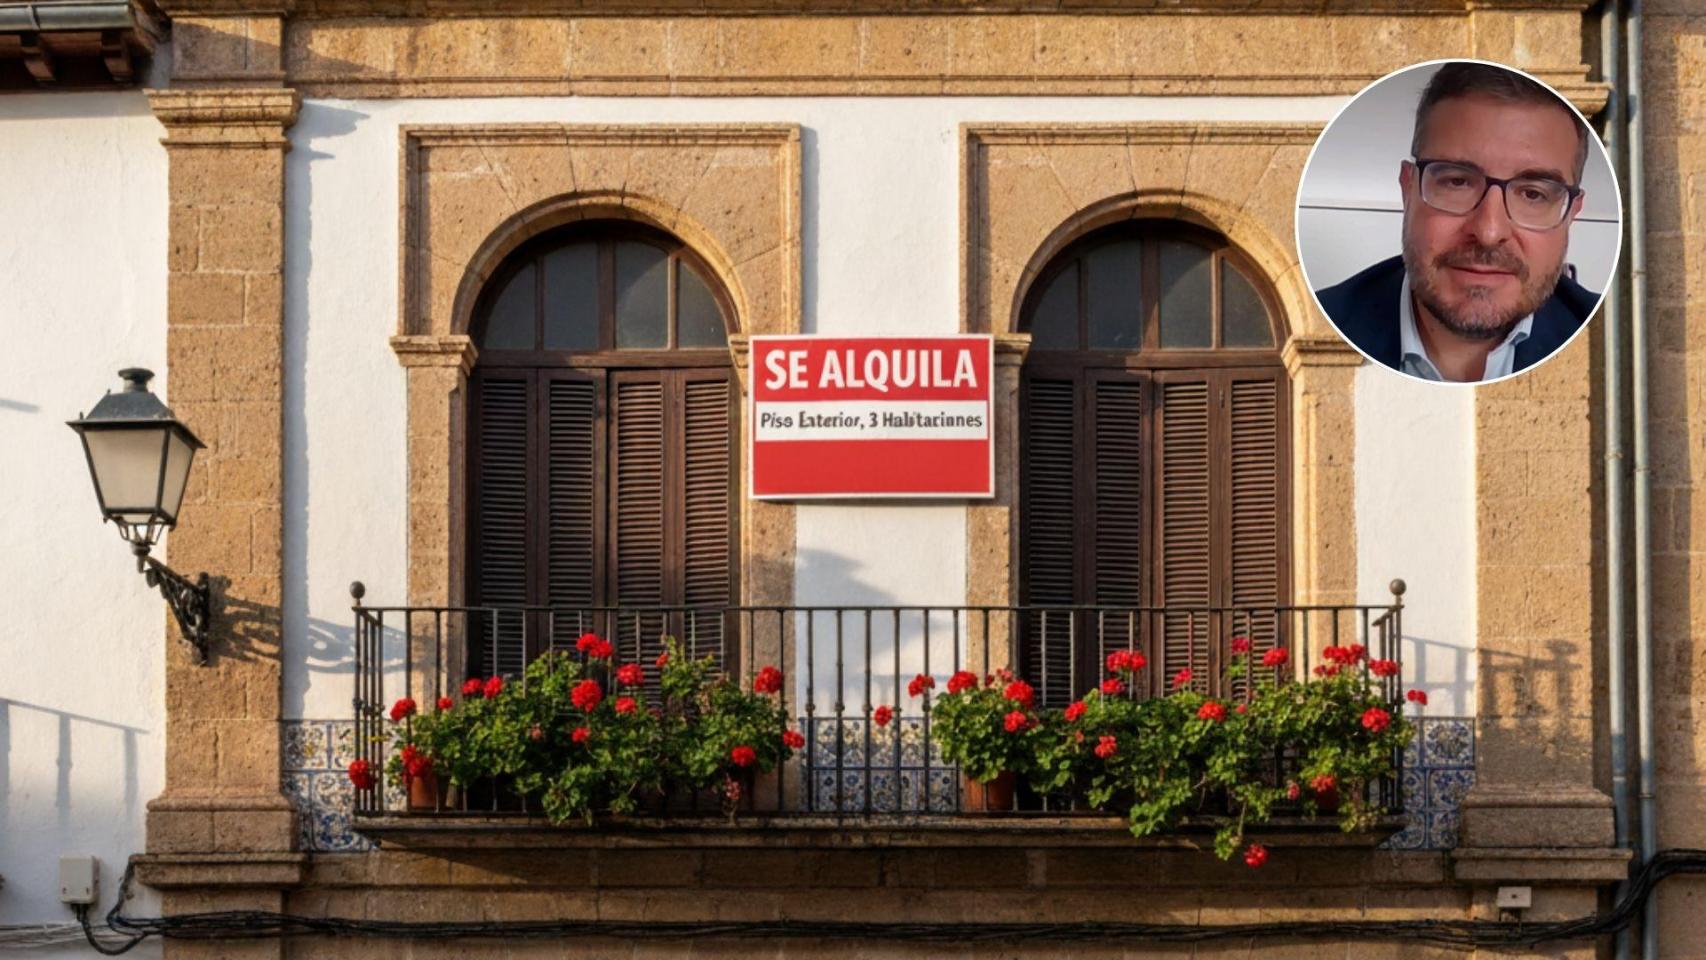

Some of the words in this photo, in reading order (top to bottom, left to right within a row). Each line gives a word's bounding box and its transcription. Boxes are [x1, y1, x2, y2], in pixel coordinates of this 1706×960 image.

[765, 349, 808, 390] SE
[818, 349, 977, 392] ALQUILA
[869, 412, 878, 427] 3
